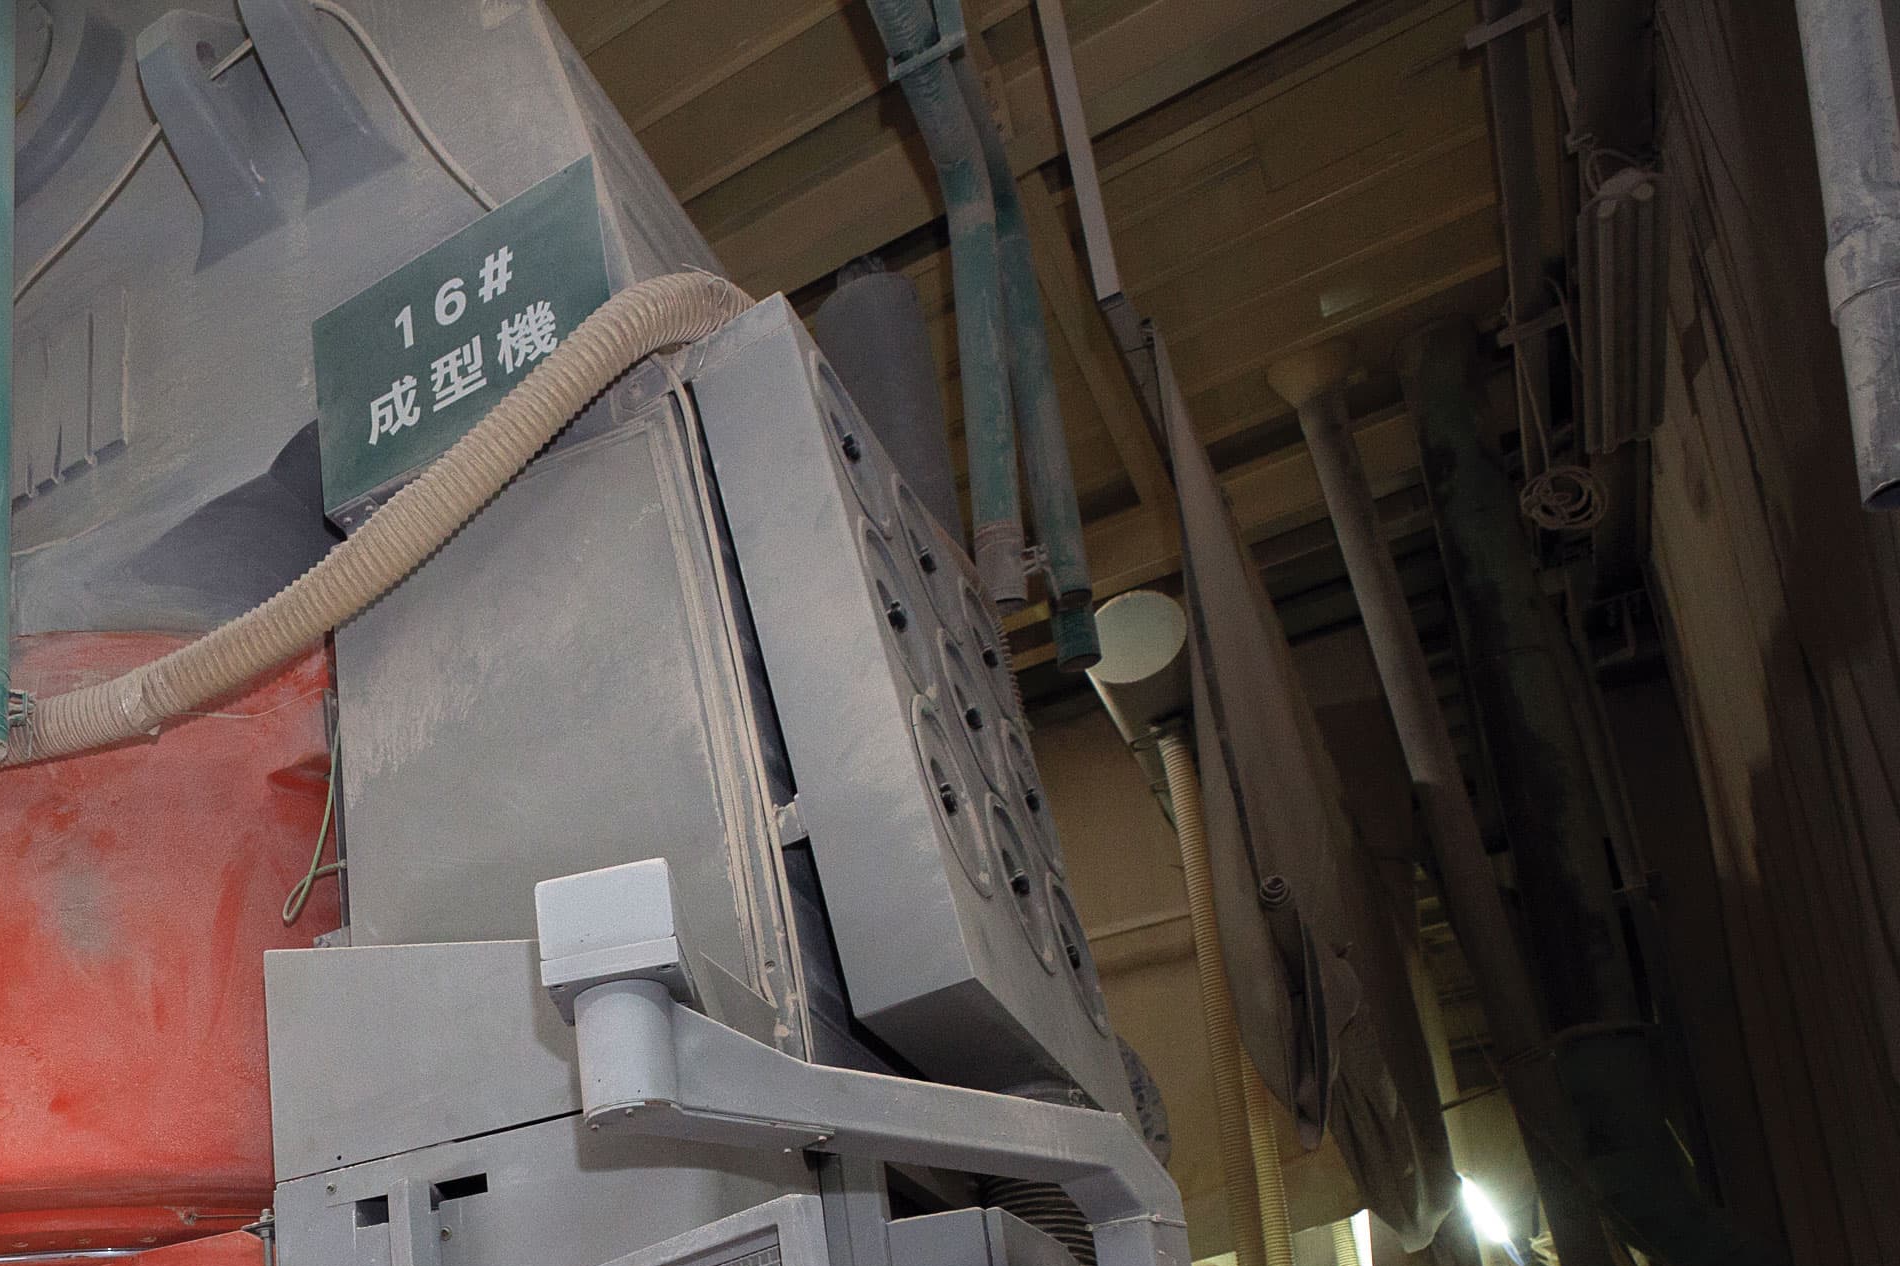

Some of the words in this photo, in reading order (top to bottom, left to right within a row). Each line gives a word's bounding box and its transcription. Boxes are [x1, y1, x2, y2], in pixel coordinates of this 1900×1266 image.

[394, 246, 514, 350] 16#
[367, 301, 558, 446] 成型機
